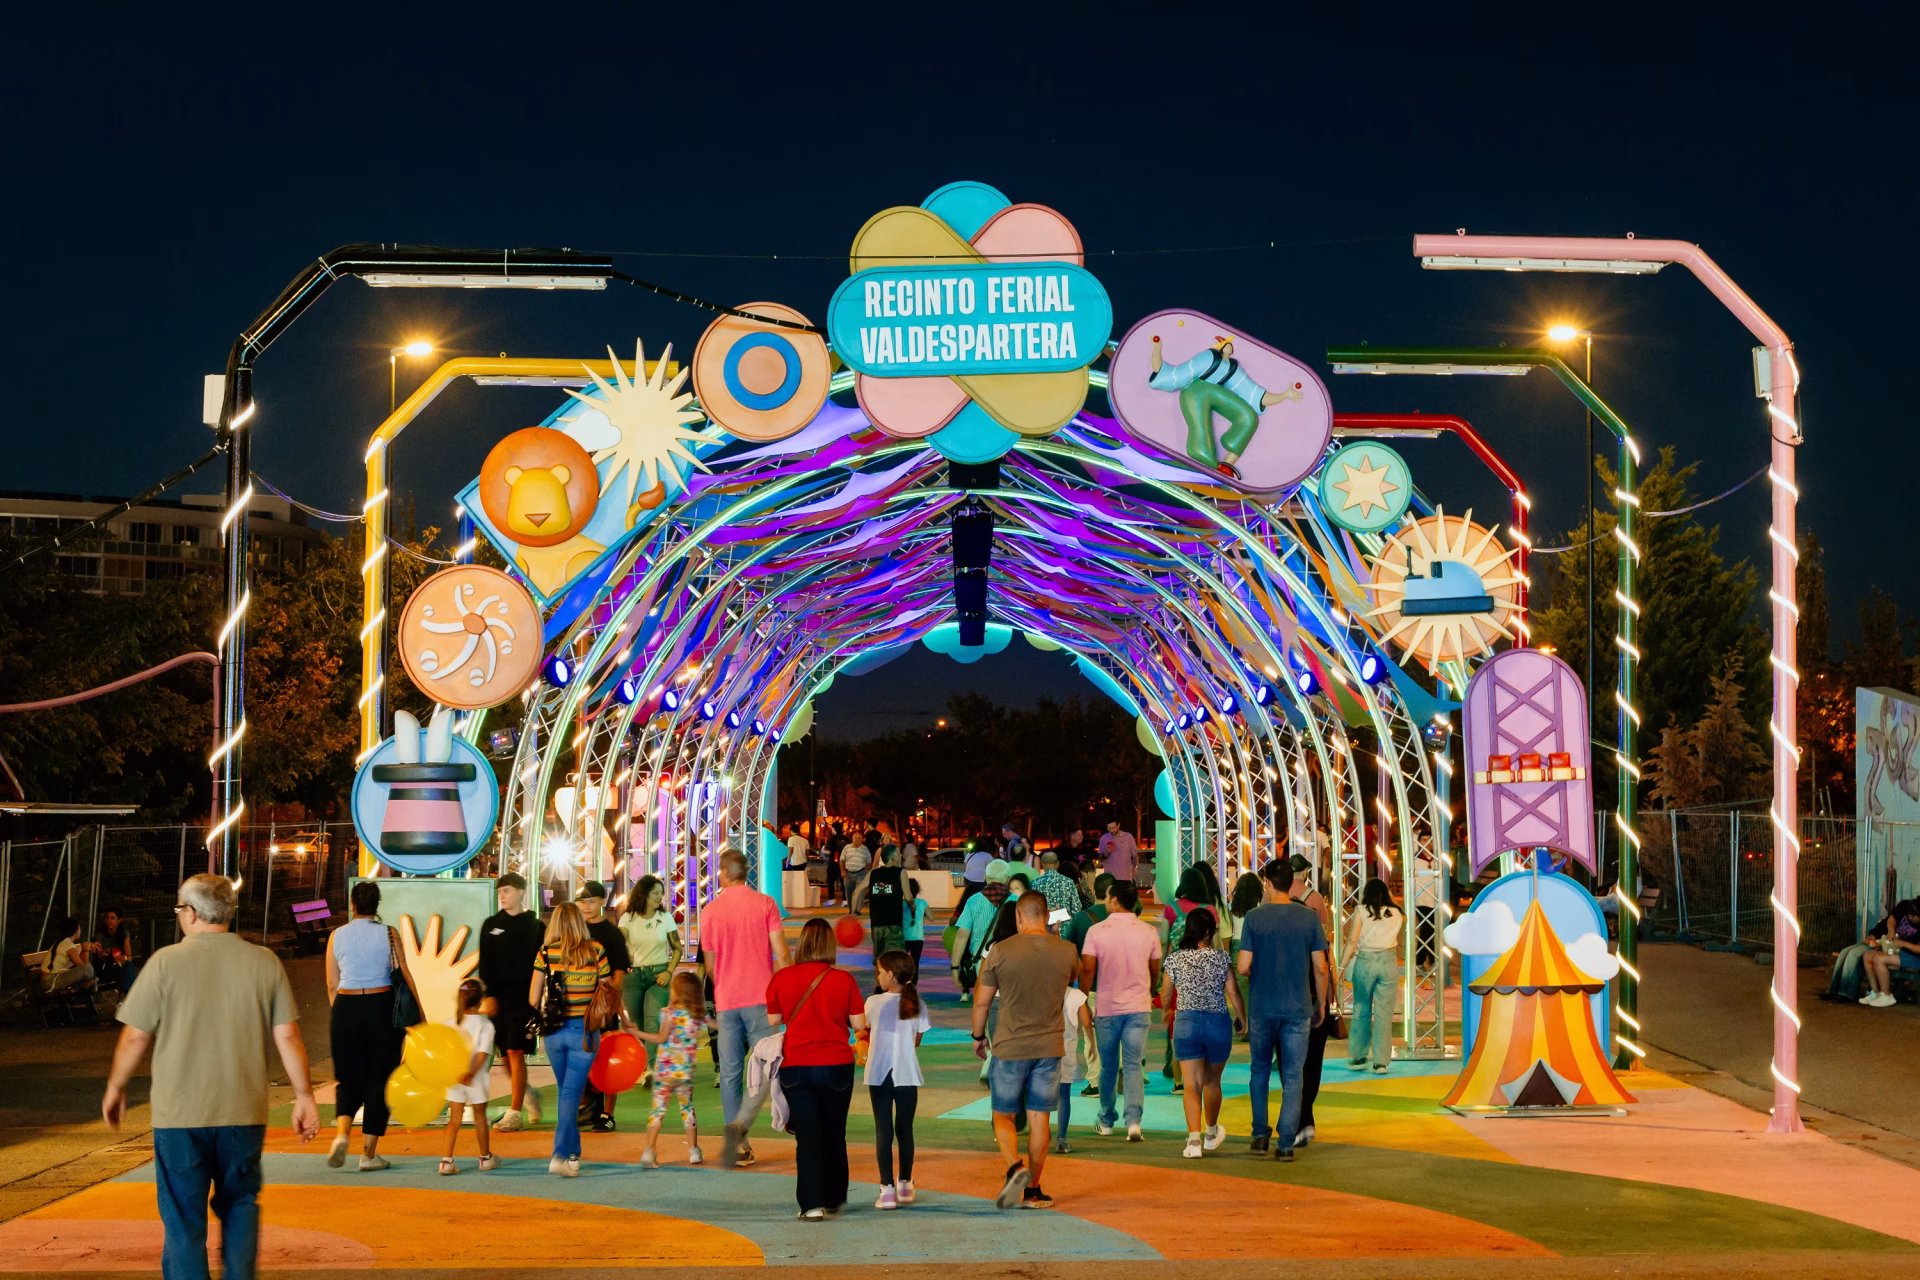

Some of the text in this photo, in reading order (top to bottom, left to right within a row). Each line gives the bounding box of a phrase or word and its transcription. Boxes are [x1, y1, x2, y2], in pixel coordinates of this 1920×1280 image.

[865, 275, 1075, 317] RECINTO FERIAL
[860, 322, 1077, 364] VALDESPARTERA
